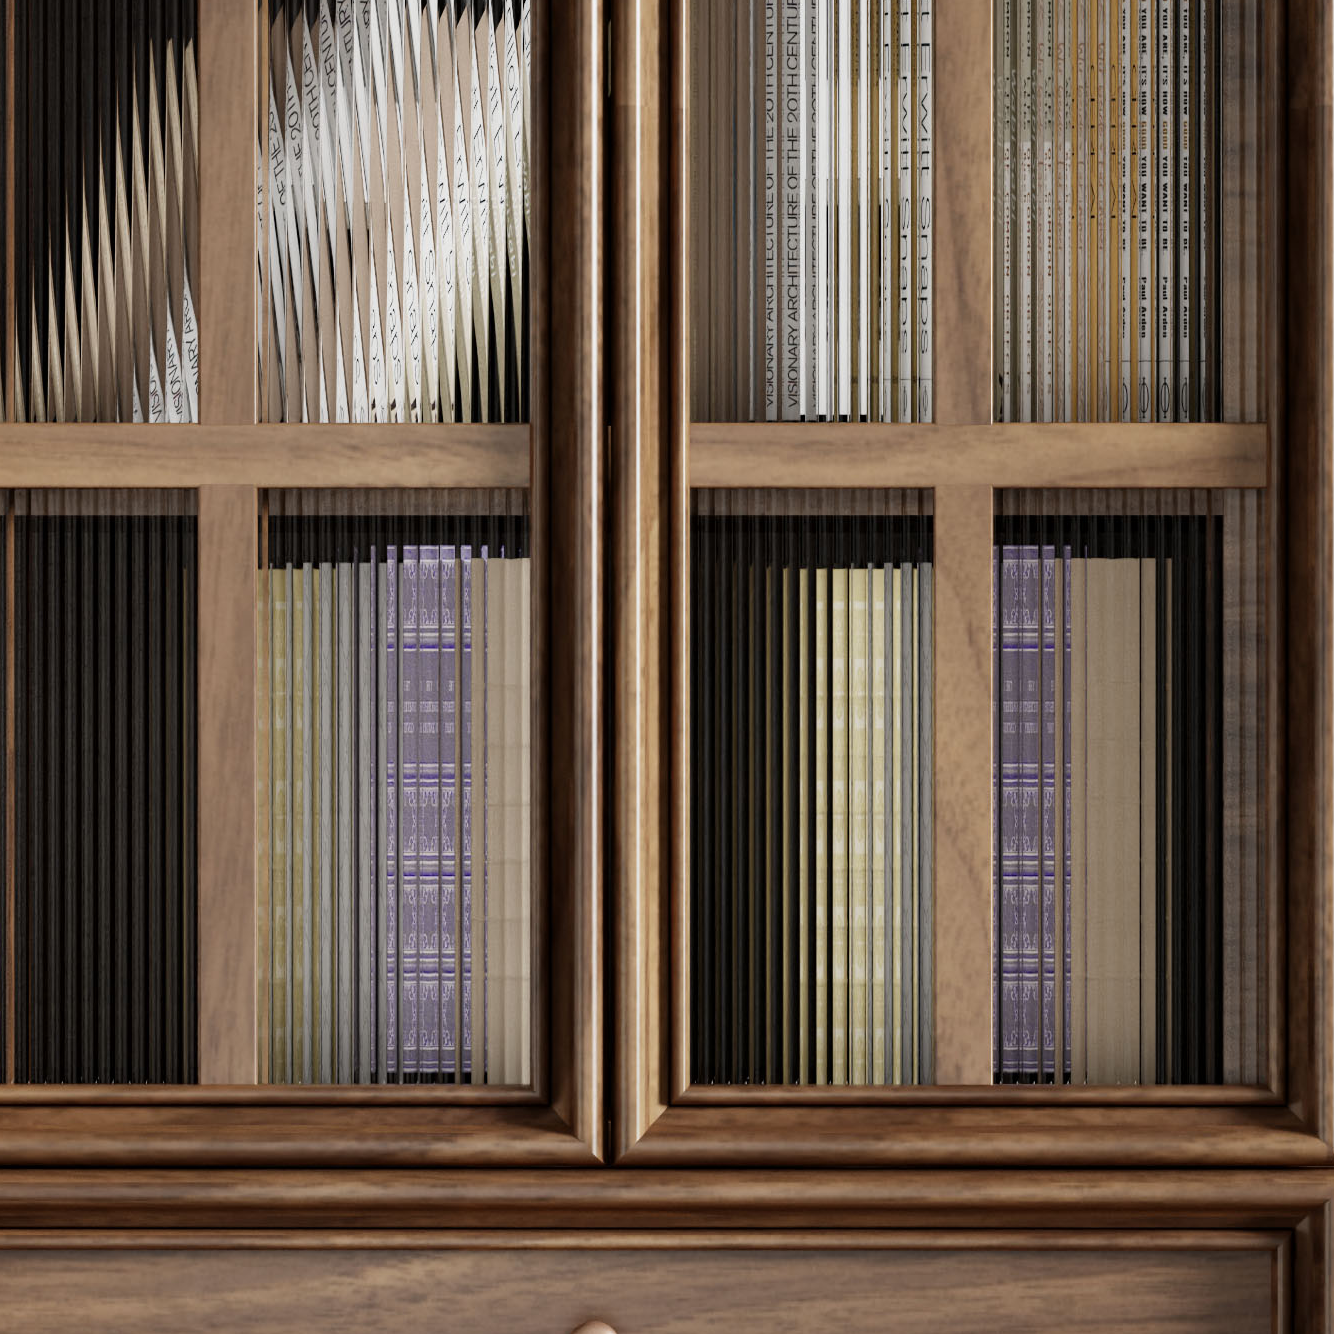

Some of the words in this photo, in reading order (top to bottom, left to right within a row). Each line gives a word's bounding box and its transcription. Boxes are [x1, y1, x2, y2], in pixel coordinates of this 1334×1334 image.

[786, 74, 799, 124] 20TH
[919, 43, 931, 176] Erwitt
[786, 127, 799, 164] THE
[786, 166, 799, 190] OF
[786, 193, 799, 322] ARCHITECTURE
[919, 196, 931, 355] Snaps
[786, 325, 799, 408] VISIONARY
